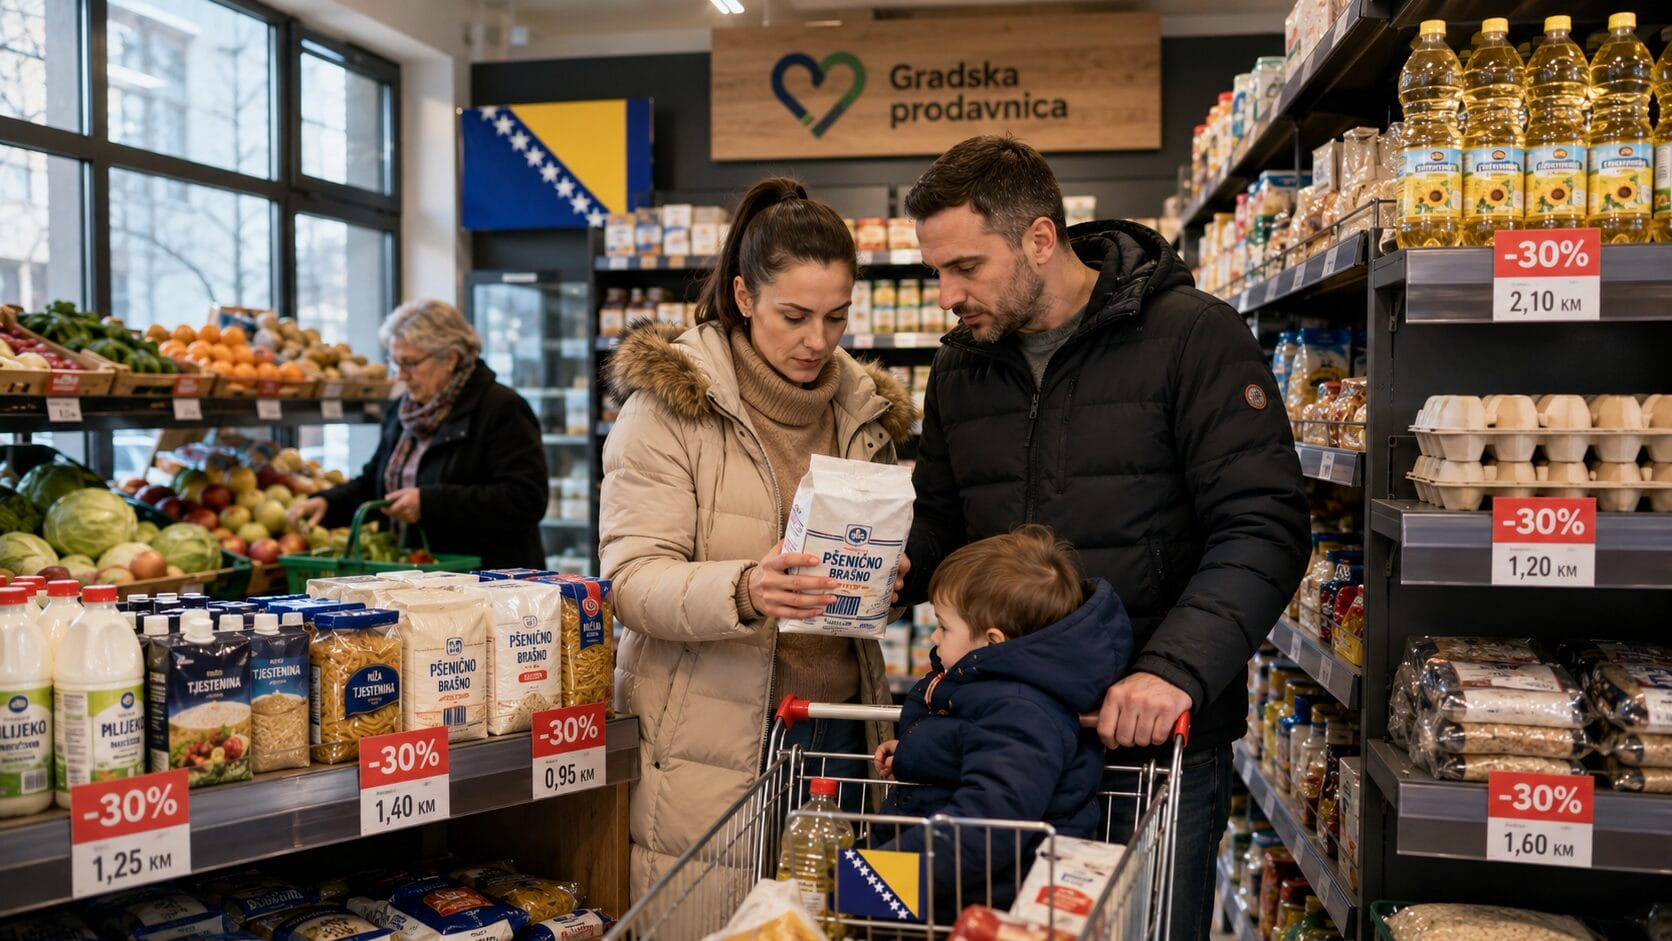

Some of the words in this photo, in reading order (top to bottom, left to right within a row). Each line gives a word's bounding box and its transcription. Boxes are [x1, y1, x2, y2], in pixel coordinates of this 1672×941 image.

[890, 61, 1019, 90] Gradska
[890, 92, 1068, 128] prodavnica
[1504, 239, 1589, 269] -30%
[1510, 290, 1554, 315] 2,10
[1561, 298, 1582, 311] KM
[1503, 507, 1585, 535] -30%
[822, 549, 883, 570] PŠENIČNO
[1509, 555, 1551, 580] 1,20
[1557, 565, 1577, 577] KM
[829, 567, 870, 582] BRAŠNO
[509, 630, 552, 648] PŠENIČNO
[430, 658, 476, 677] PŠENIČNO
[517, 648, 547, 663] BRAŠNO
[252, 665, 301, 680] TJESTENINA
[438, 676, 470, 693] BRAŠNO
[187, 676, 241, 697] TJESTENINA
[0, 720, 47, 740] LIJEKO
[539, 713, 598, 746] -30%
[368, 738, 440, 775] -30%
[545, 763, 576, 791] 0,95
[580, 768, 595, 782] KM
[83, 783, 178, 827] -30%
[376, 794, 412, 825] 1,40
[418, 799, 436, 815] KM
[1499, 783, 1582, 814] -30%
[1504, 832, 1548, 857] 1,60
[1553, 843, 1574, 857] KM
[93, 848, 142, 885] 1,25
[149, 853, 172, 871] KM
